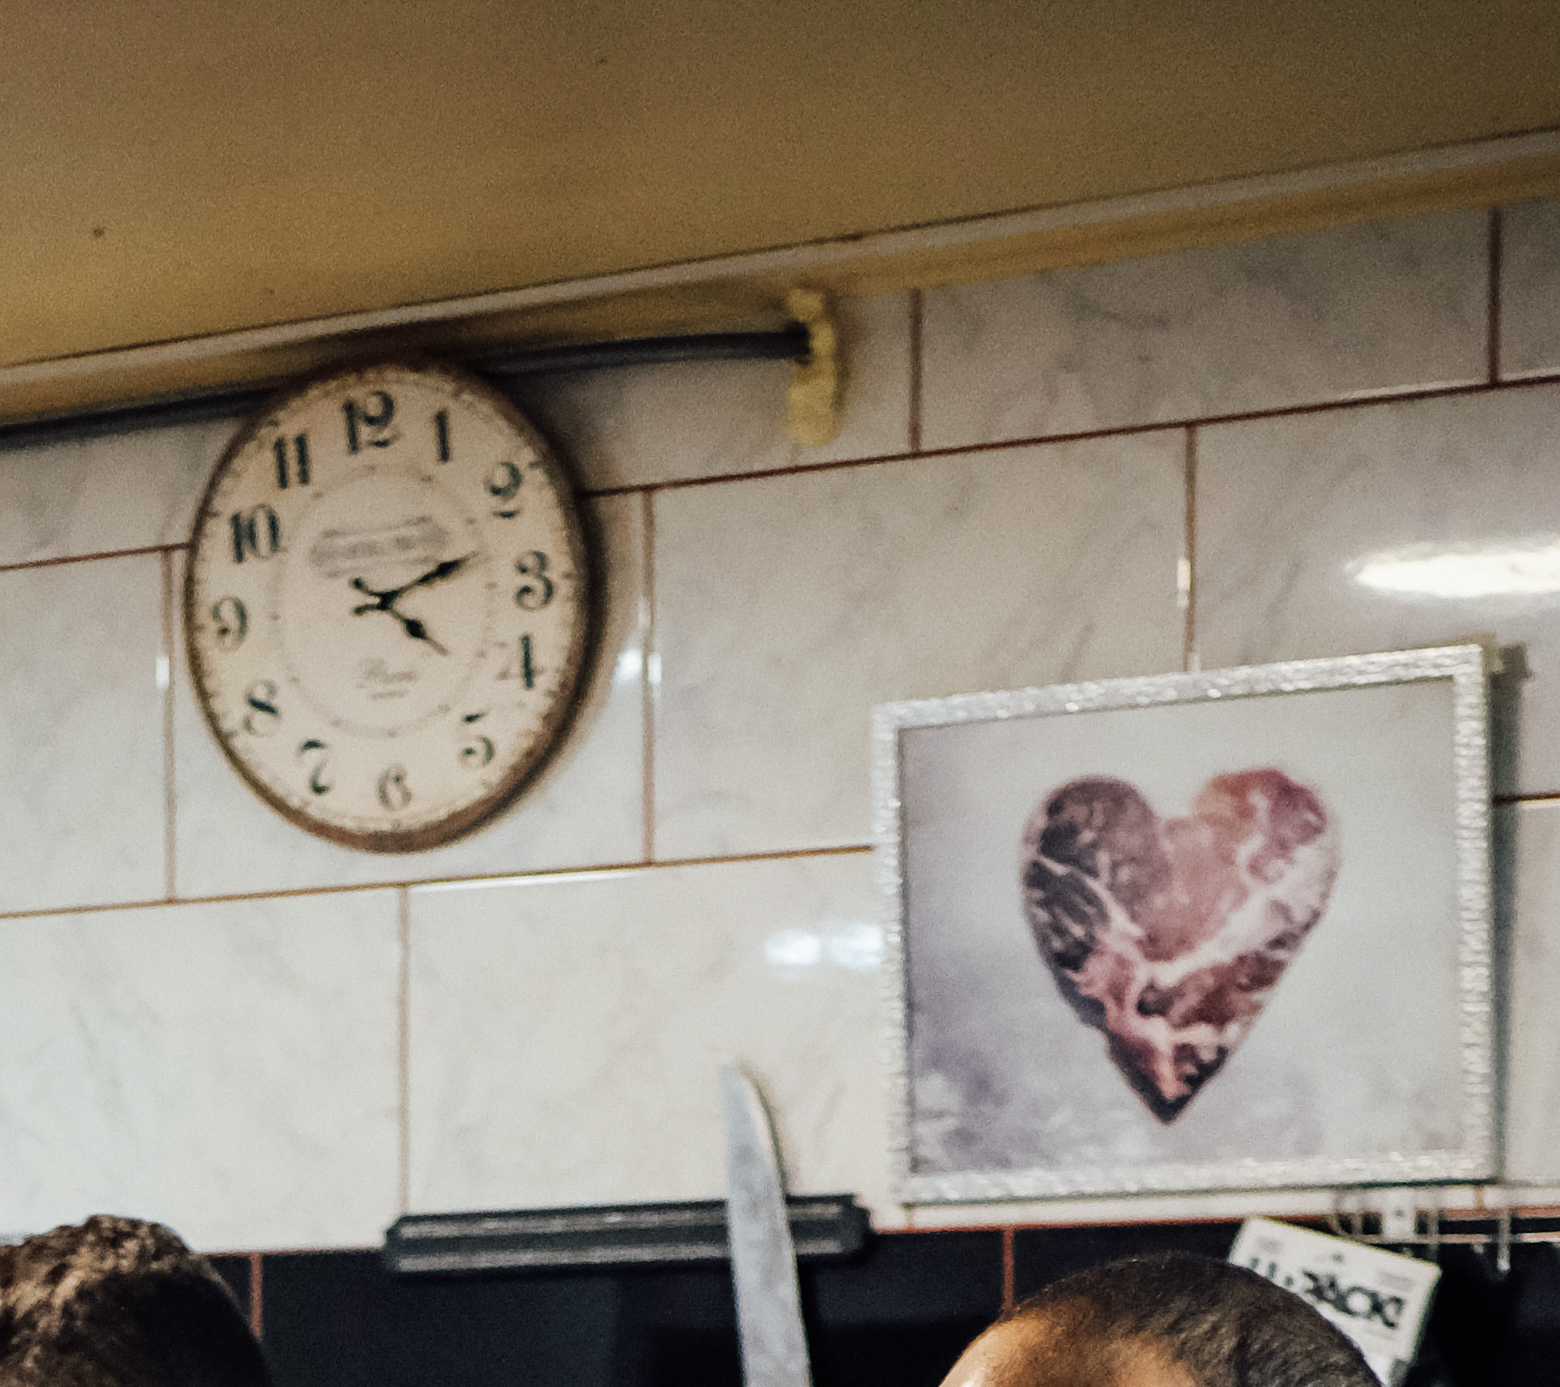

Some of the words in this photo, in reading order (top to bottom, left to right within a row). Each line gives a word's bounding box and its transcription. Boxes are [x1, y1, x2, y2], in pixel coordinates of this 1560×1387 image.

[343, 389, 396, 454] 12
[434, 409, 452, 462] 1
[273, 433, 311, 490] 11
[484, 461, 522, 519] 2
[230, 503, 282, 563] 10
[515, 549, 555, 611] 3
[212, 595, 248, 653] 9
[495, 634, 542, 689] 4
[242, 679, 279, 737] 8
[298, 739, 330, 795] 7
[461, 711, 495, 770] 5
[378, 763, 413, 811] 6
